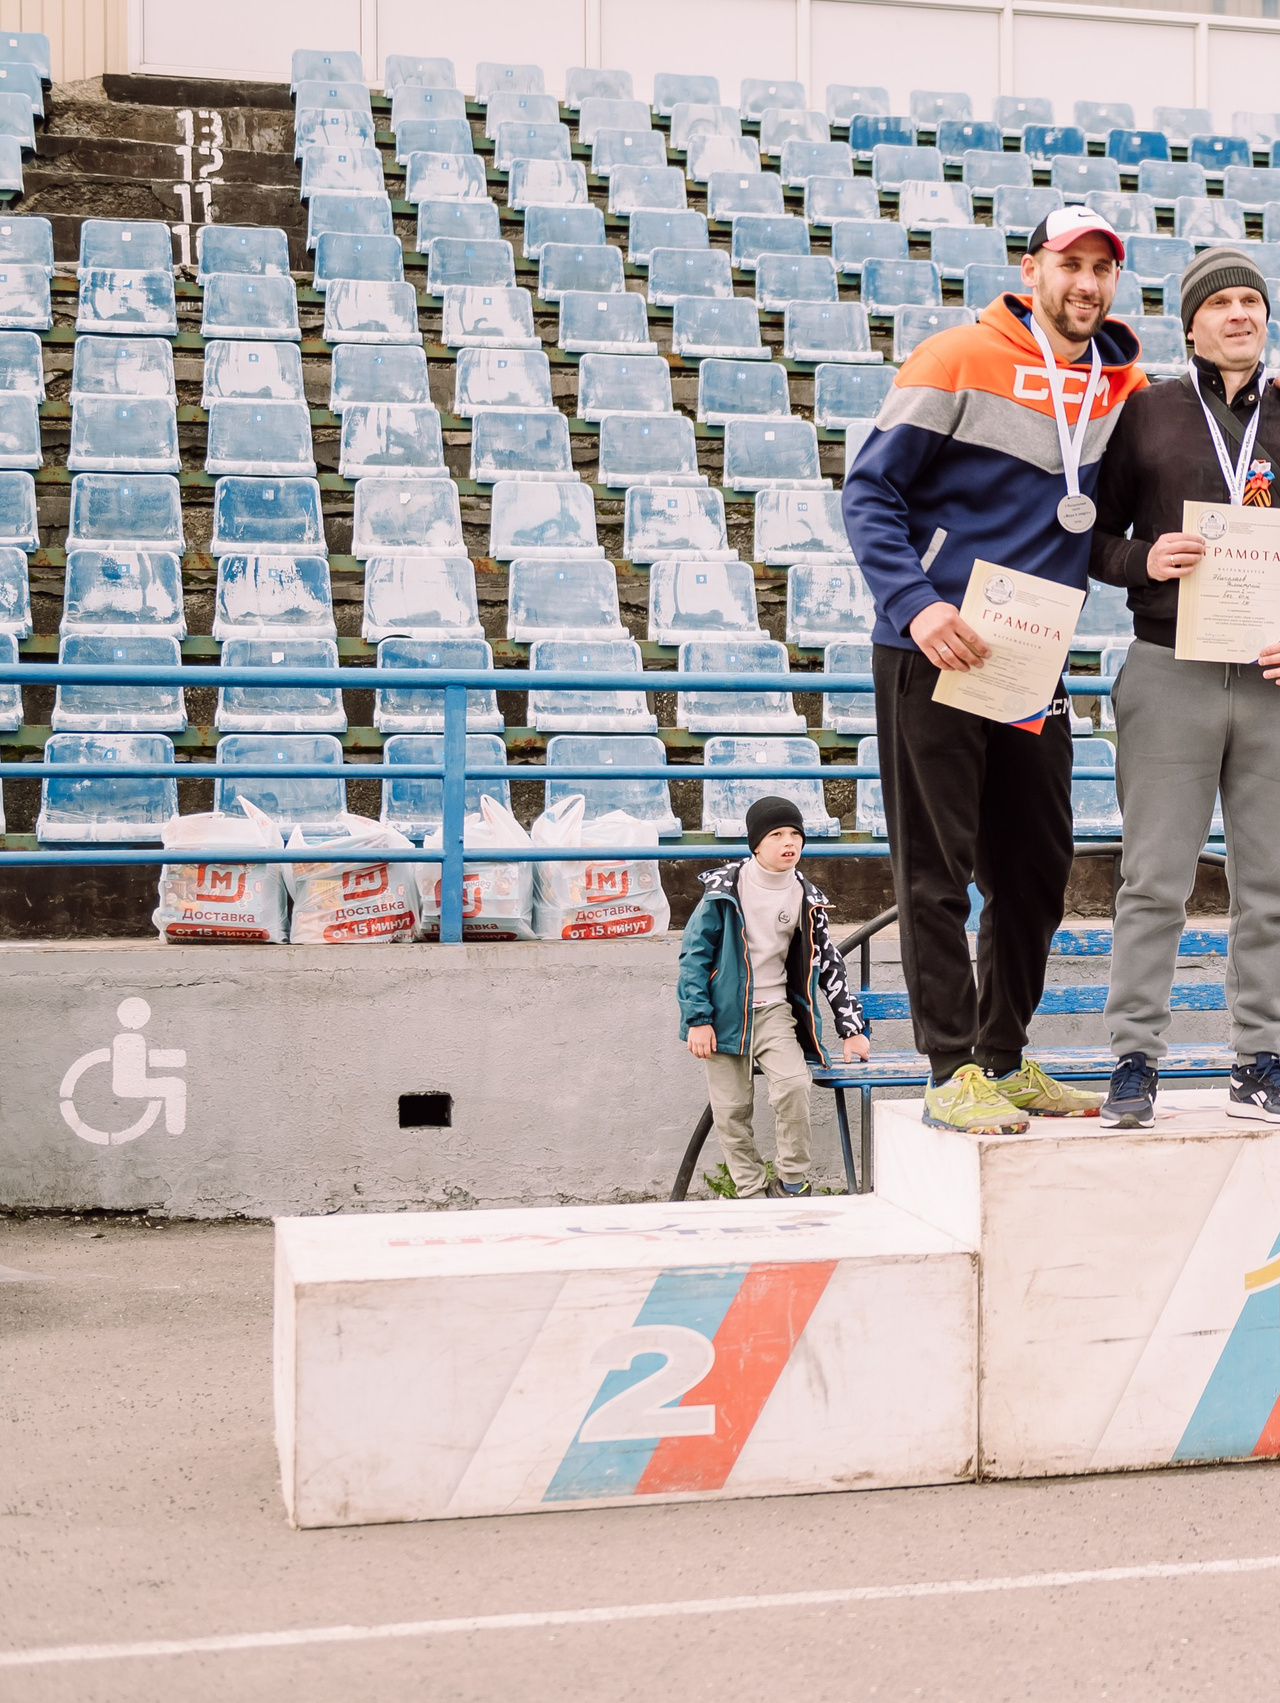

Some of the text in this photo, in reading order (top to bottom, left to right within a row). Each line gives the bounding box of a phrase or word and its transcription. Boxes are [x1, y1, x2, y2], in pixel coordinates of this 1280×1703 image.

[177, 109, 224, 147] 13
[175, 146, 225, 184] 12
[173, 182, 214, 223] 11
[172, 224, 202, 266] 1
[982, 608, 1062, 641] ГРАМОТА
[182, 908, 256, 923] Доставка
[335, 900, 405, 921] Доставка
[576, 905, 641, 922] Доставка
[196, 928, 213, 936] 15
[332, 917, 411, 939] от 15 минут
[570, 919, 648, 938] от 15 минут
[580, 1324, 717, 1444] 2
